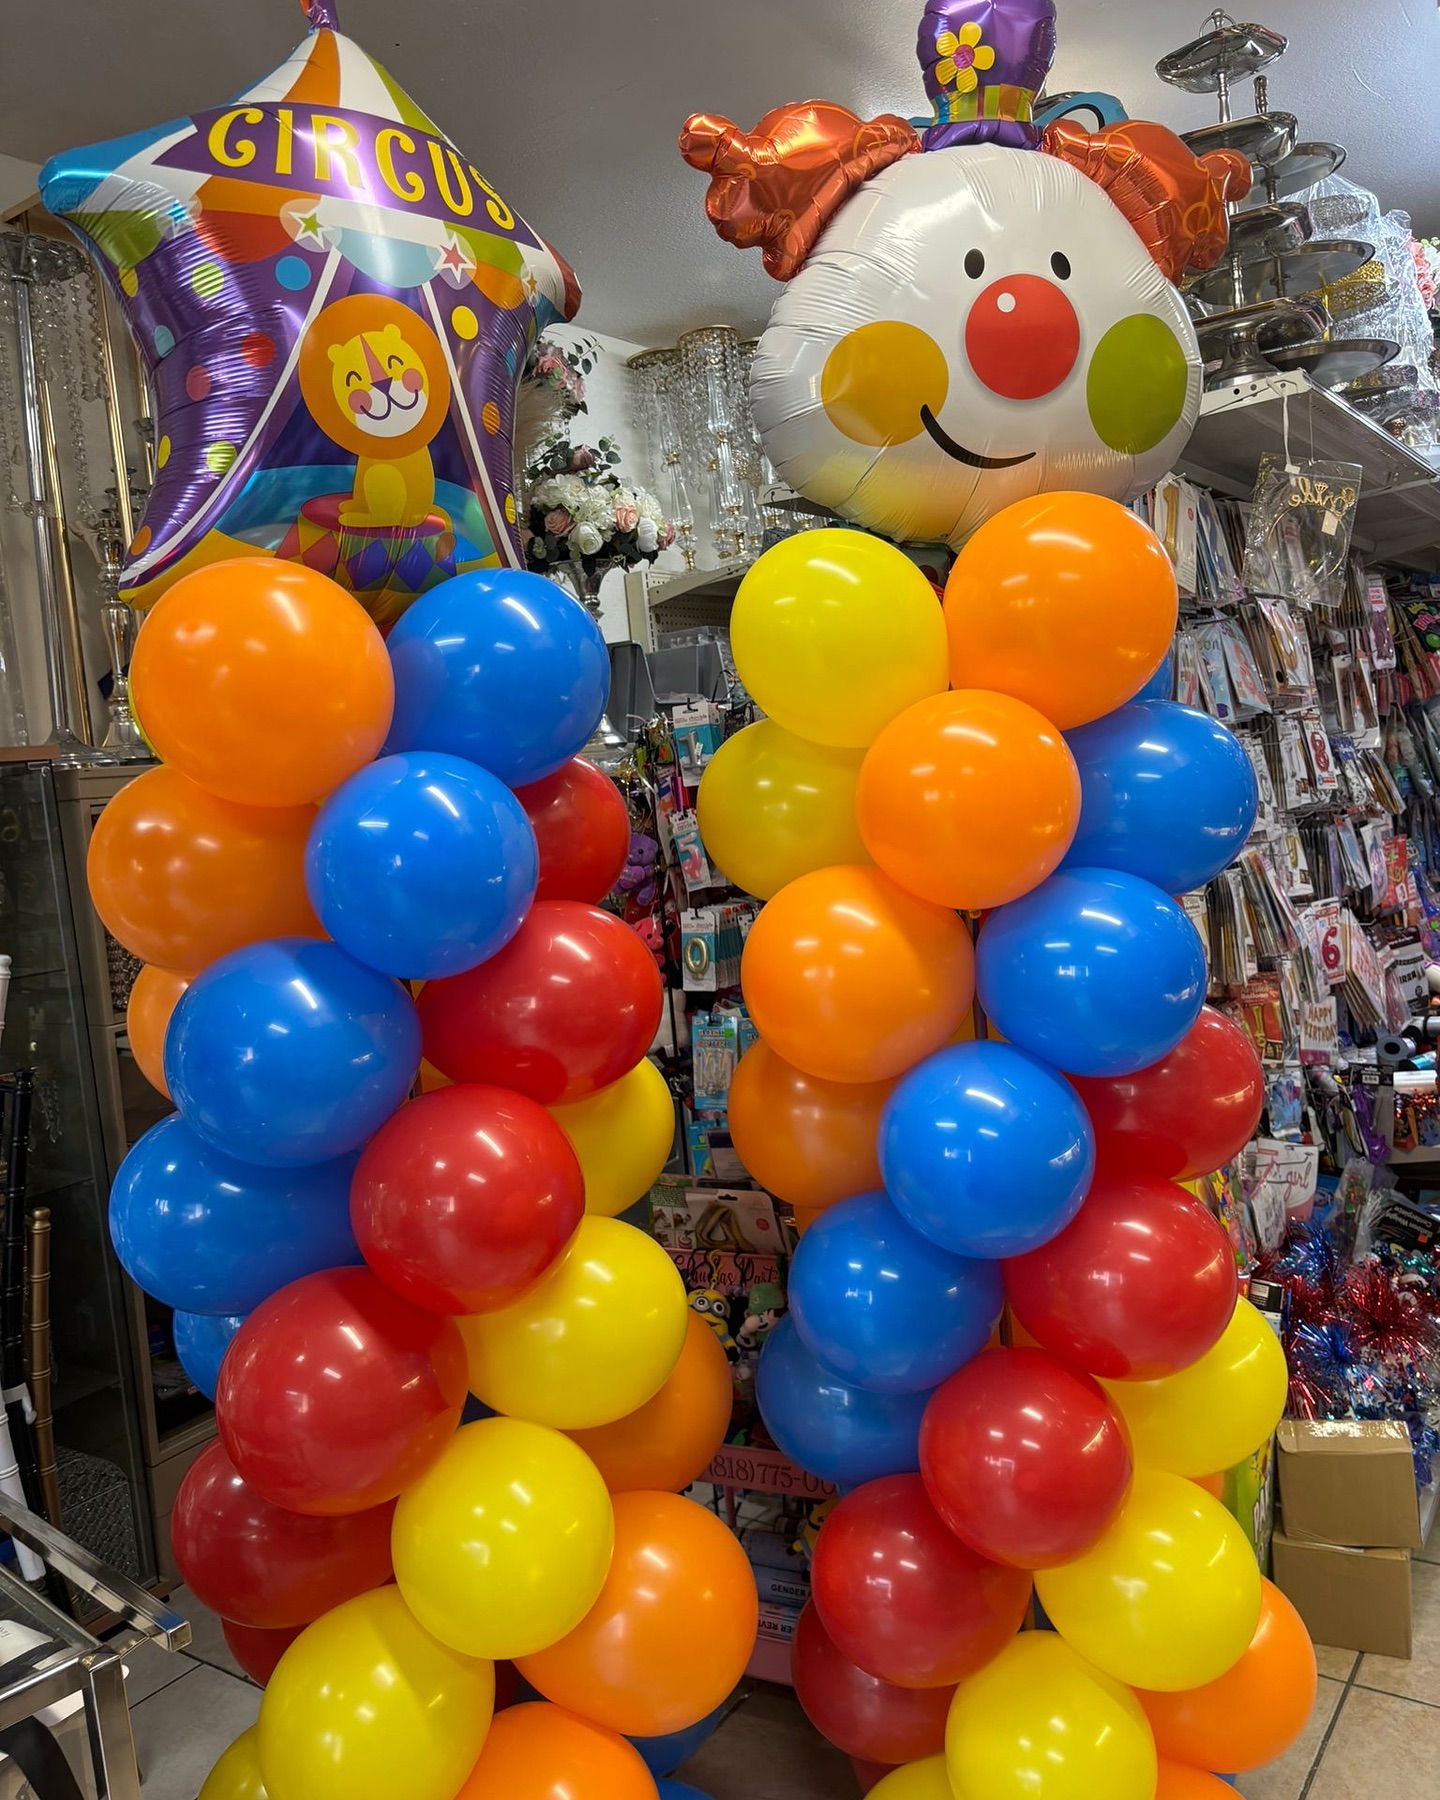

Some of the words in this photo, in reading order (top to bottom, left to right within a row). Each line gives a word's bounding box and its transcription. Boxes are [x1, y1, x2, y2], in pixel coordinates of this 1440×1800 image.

[207, 106, 516, 231] CIRCUS
[1321, 926, 1340, 970] 6
[1283, 1161, 1312, 1201] girl
[770, 1584, 807, 1597] GENDER
